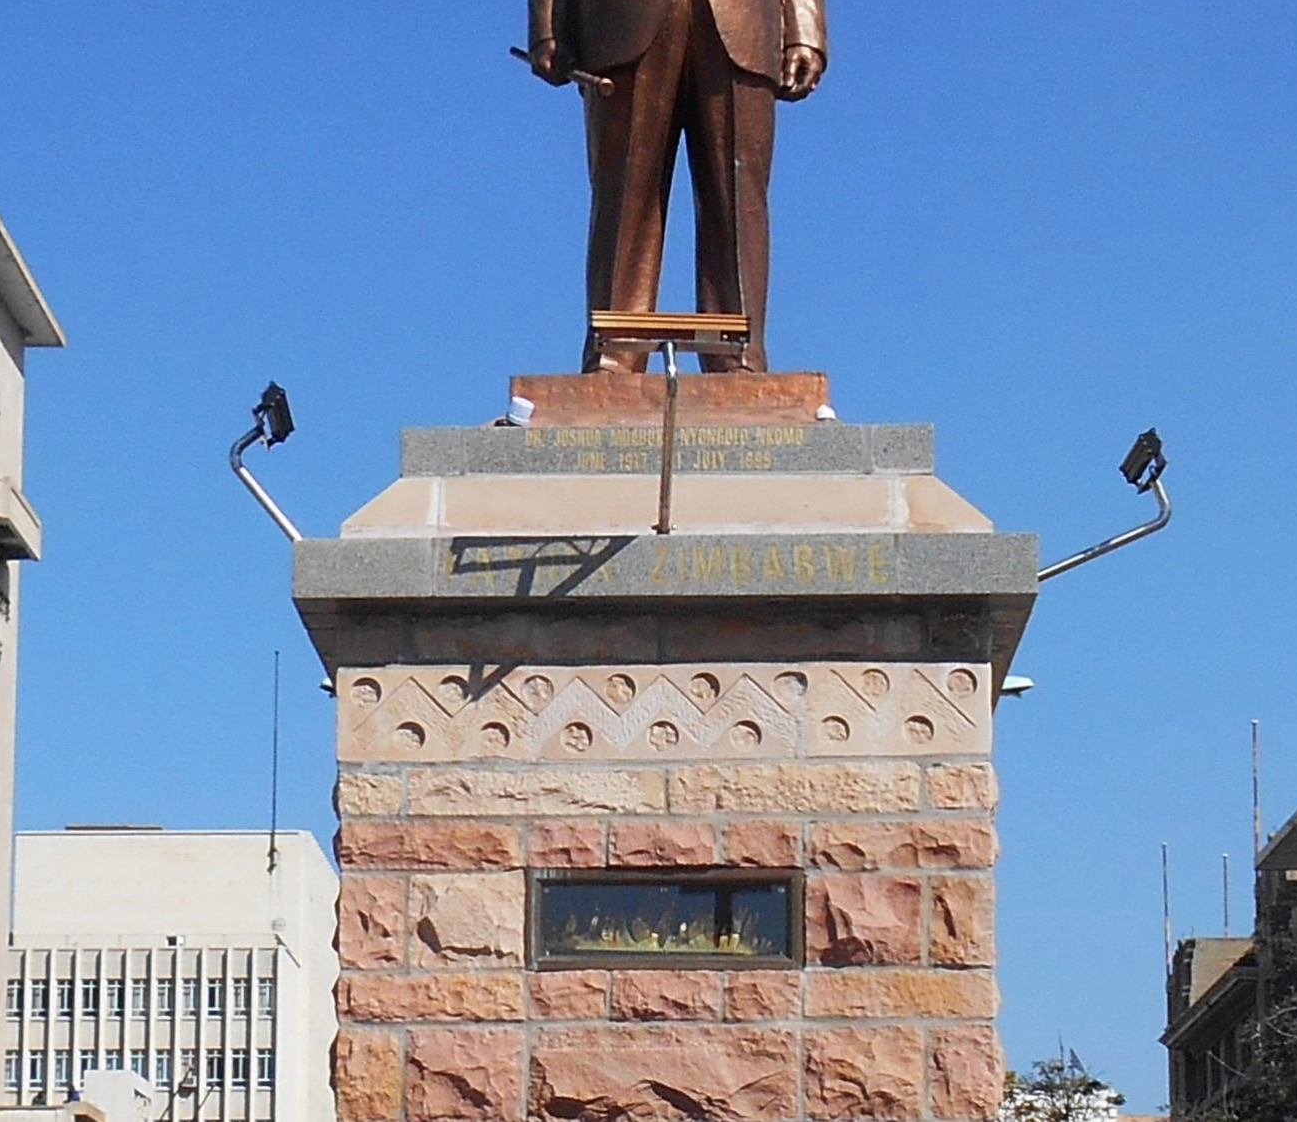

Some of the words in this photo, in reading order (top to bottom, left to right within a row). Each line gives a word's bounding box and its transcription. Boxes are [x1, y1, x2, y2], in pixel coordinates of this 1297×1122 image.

[554, 428, 602, 447] JOSHUA
[757, 427, 803, 446] NKOMO
[575, 451, 608, 470] JUNE
[619, 452, 648, 471] 1917
[693, 451, 727, 470] JULY
[651, 542, 890, 584] ZIMBABWE
